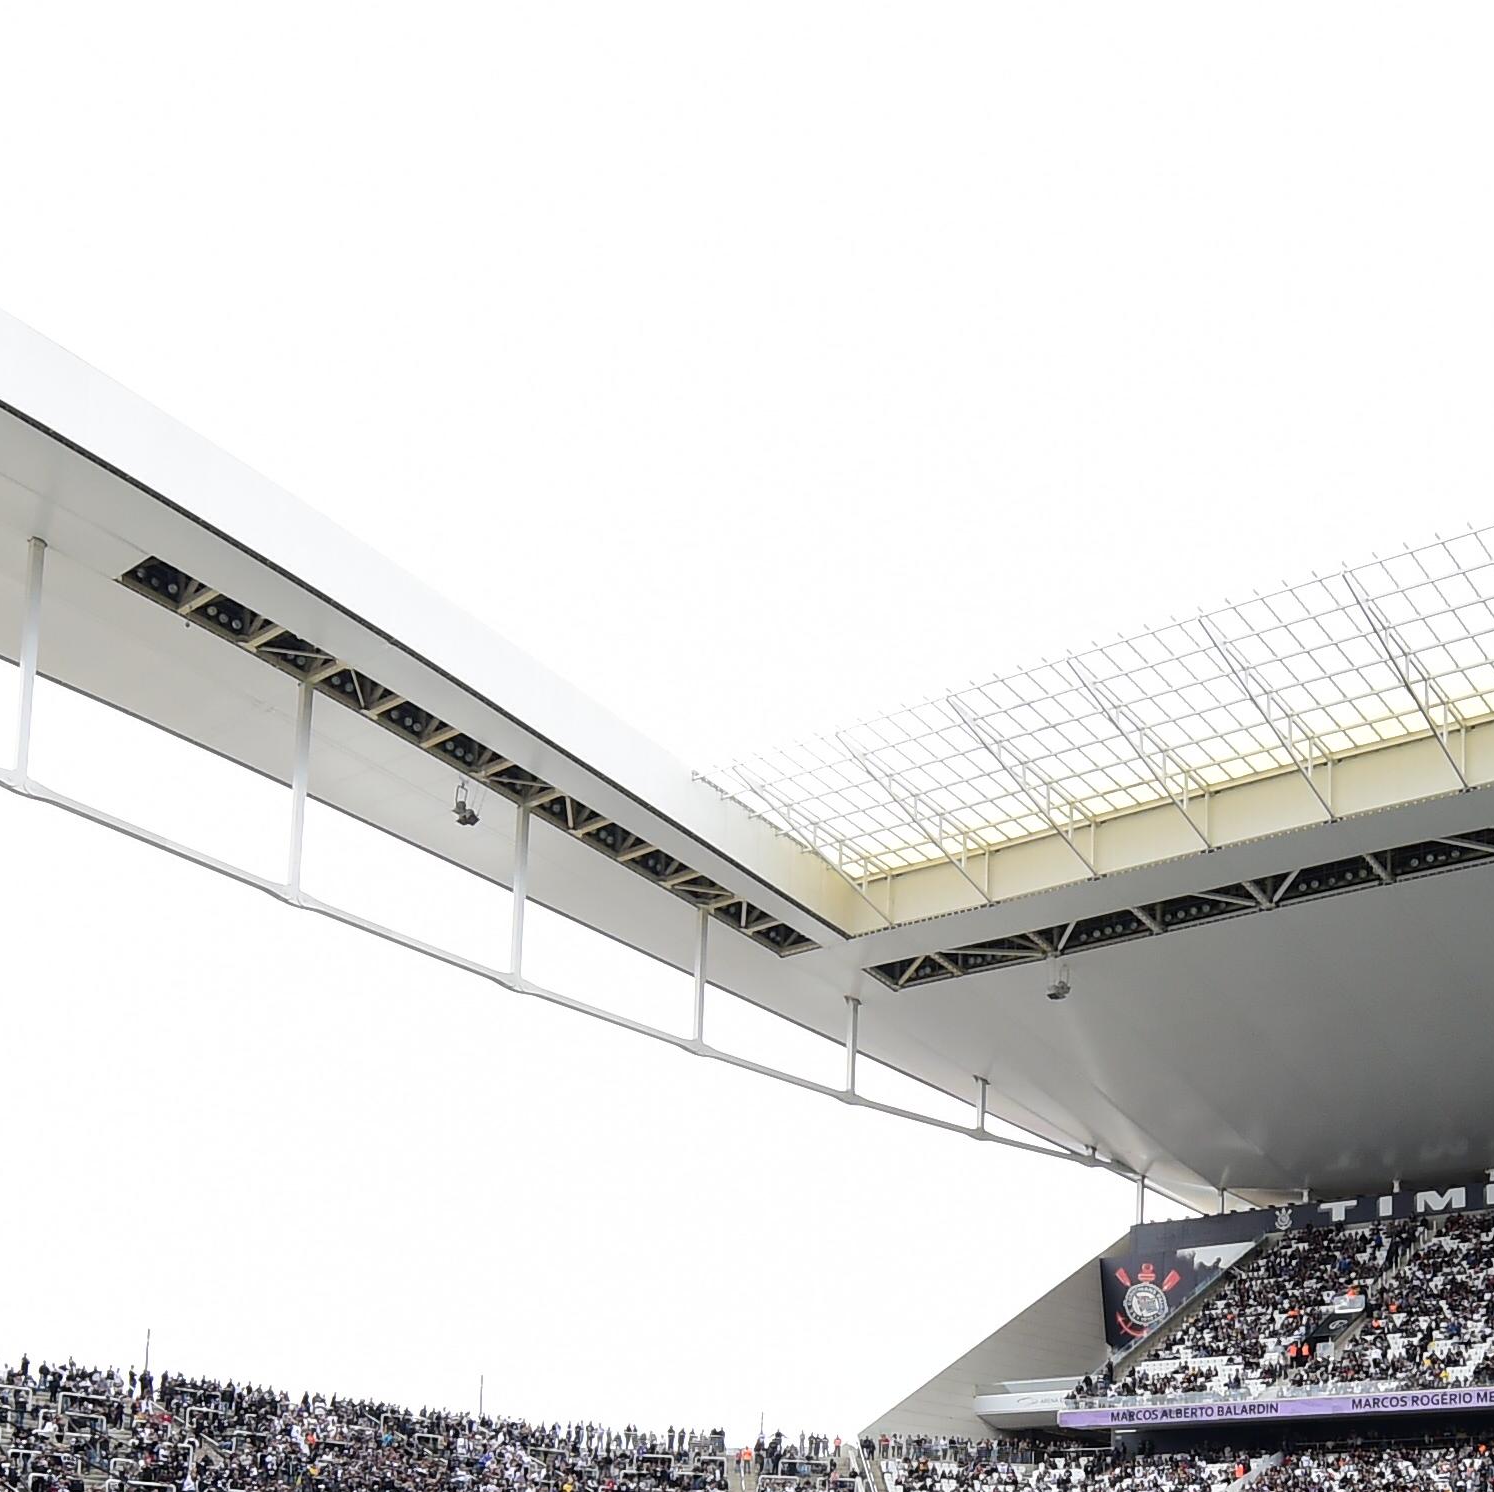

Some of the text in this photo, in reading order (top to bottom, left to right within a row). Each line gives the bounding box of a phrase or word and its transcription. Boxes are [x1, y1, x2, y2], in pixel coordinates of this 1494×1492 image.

[1351, 1396, 1407, 1410] MARCOS
[1411, 1391, 1473, 1407] ROGÉRIO
[1110, 1403, 1279, 1423] MARCOS ALBERTO BALARDIN
